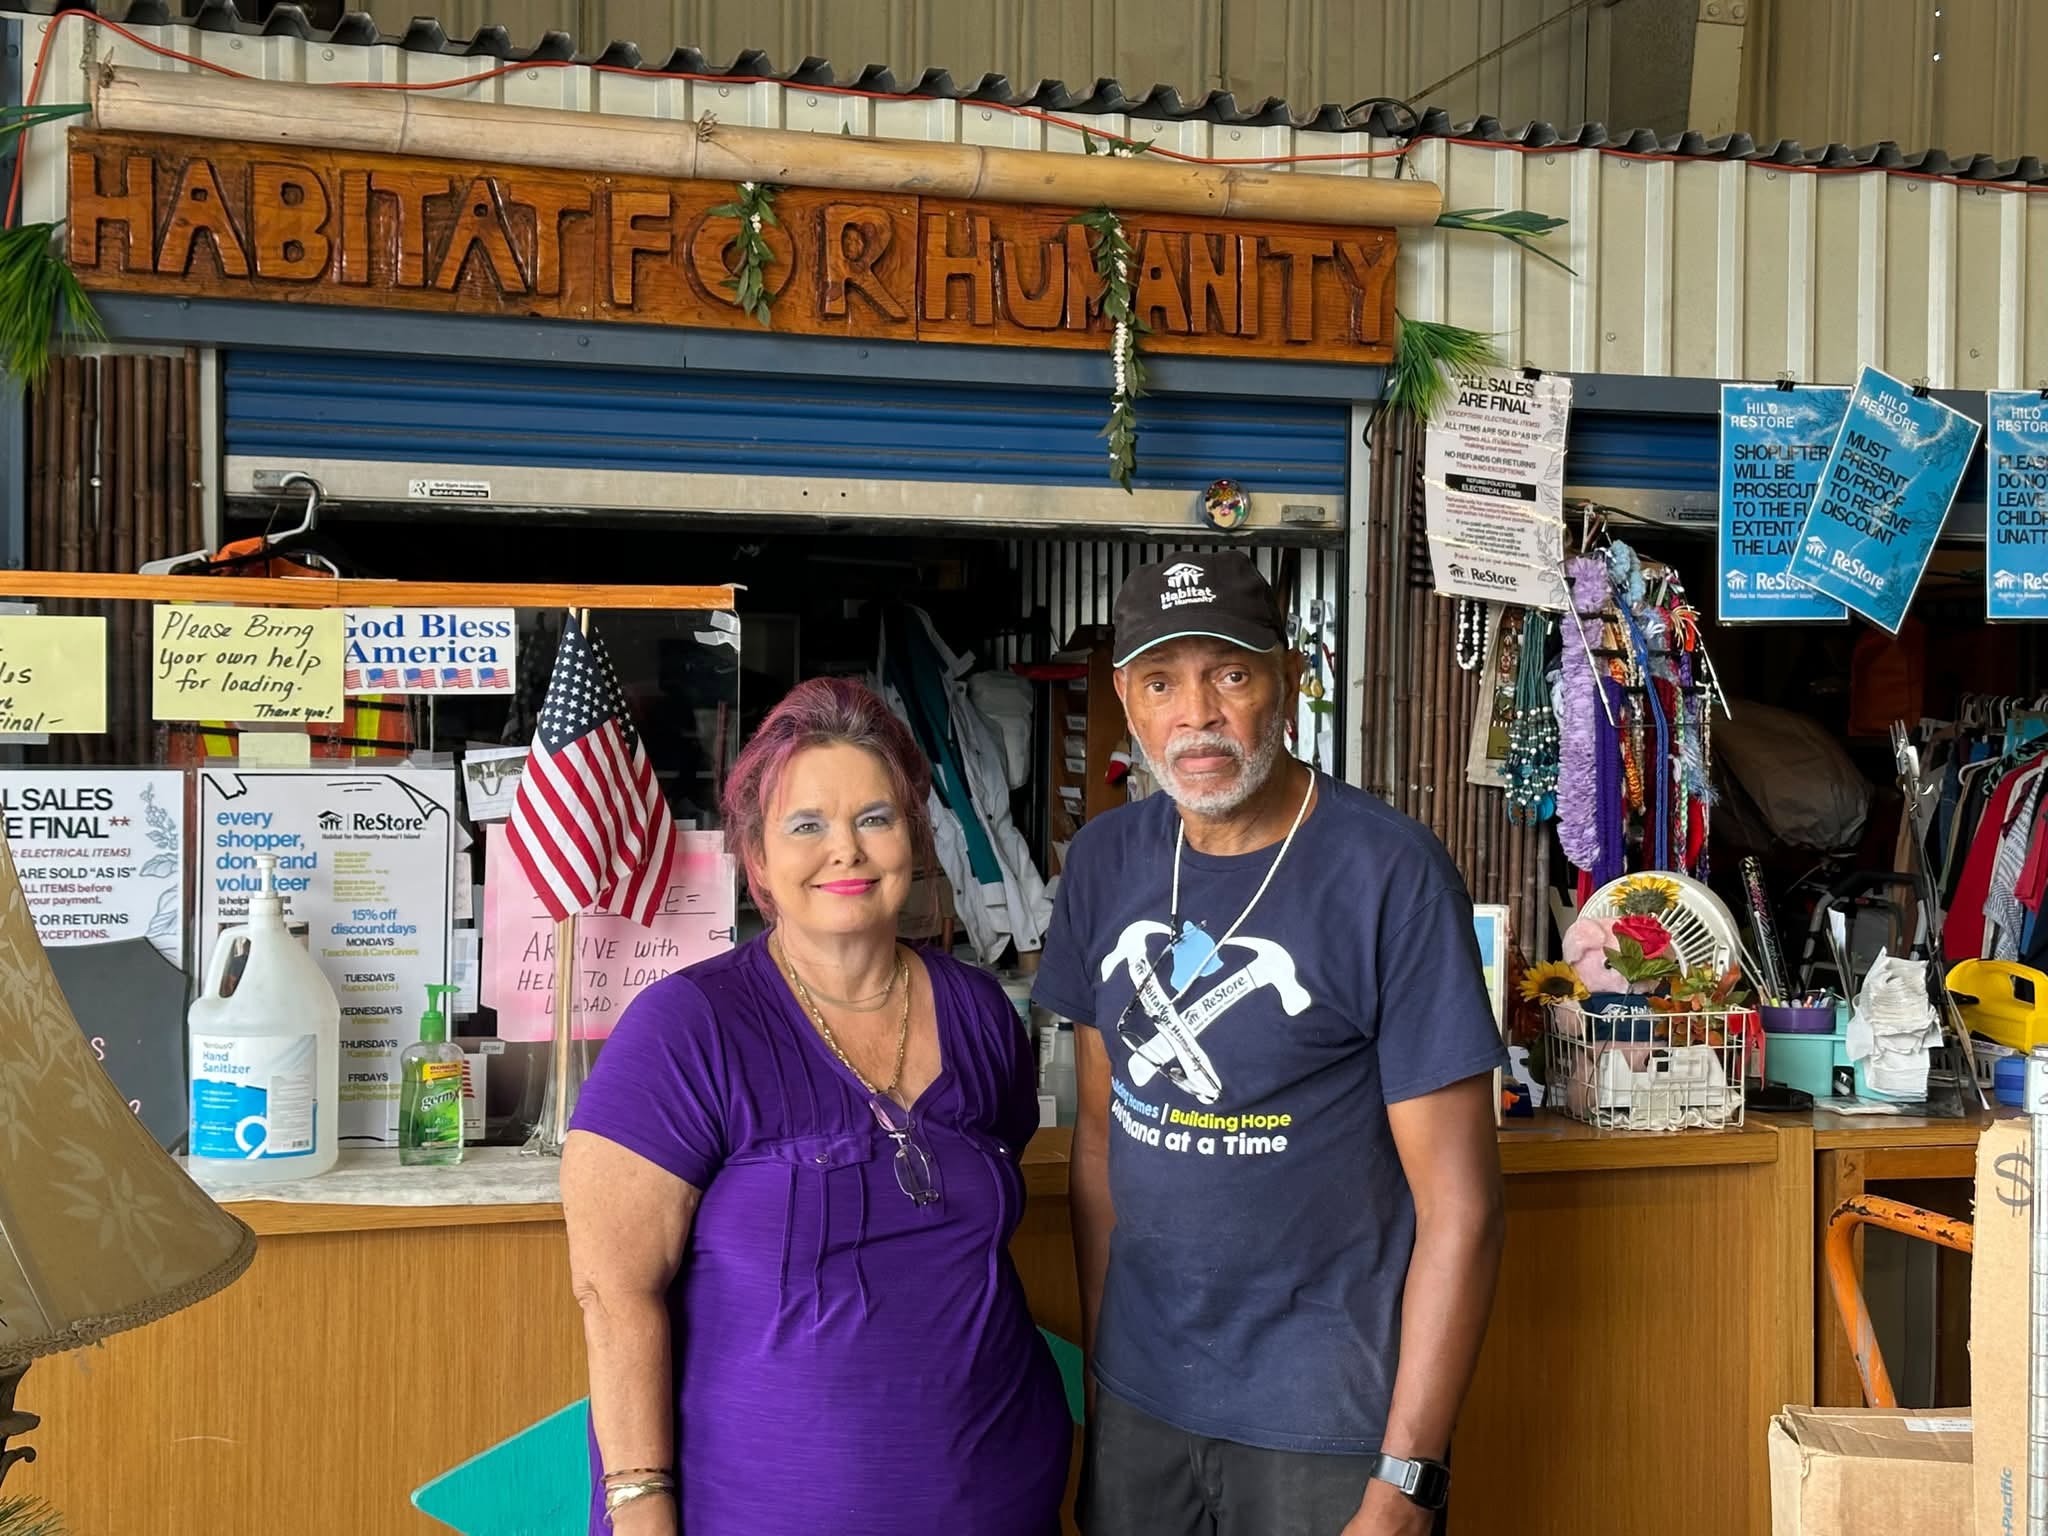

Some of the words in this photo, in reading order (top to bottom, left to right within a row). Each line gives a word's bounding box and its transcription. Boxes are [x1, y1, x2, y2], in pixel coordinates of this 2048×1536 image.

[68, 152, 593, 297] HABITAT
[610, 190, 908, 322] FOR
[1488, 378, 1534, 398] SALES
[1458, 391, 1488, 409] ARE
[1746, 402, 1778, 415] HILO
[1879, 390, 1909, 414] HILO
[1731, 415, 1794, 429] RESTORE
[1859, 395, 1919, 434] RESTORE
[2011, 407, 2041, 420] HILO
[1459, 423, 1480, 433] ITEMS
[1996, 420, 2048, 432] RESTOR
[1734, 444, 1832, 461] SHOPLIFTER
[1846, 430, 1892, 462] MUST
[1444, 450, 1455, 458] NO
[1457, 452, 1490, 463] REFUNDS
[1491, 457, 1503, 465] OR
[1503, 458, 1536, 469] RETURNS
[1840, 447, 1911, 489] PRESENT
[1998, 455, 2048, 471] PLEAS
[1734, 463, 1771, 480] WILL
[1774, 463, 1795, 479] BE
[1833, 464, 1907, 509] ID/PROOF
[1998, 473, 2020, 489] DO
[1461, 484, 1501, 496] ELECTRICAL
[1733, 482, 1817, 499] PROSECUT
[1998, 492, 2046, 508] LEAVE
[1733, 502, 1756, 517] TO
[1758, 502, 1791, 518] THE
[1830, 482, 1850, 503] TO
[1850, 493, 1911, 537] RECEIVE
[1732, 520, 1795, 536] EXTENT
[1821, 499, 1897, 546] DISCOUNT
[1732, 540, 1764, 555] THE
[1471, 568, 1517, 587] ReStore
[1831, 549, 1884, 591] ReStore
[1160, 587, 1212, 605] Habitat
[161, 611, 232, 641] Please
[244, 614, 314, 649] Bring
[418, 614, 511, 639] Bless
[344, 640, 498, 664] America
[216, 652, 257, 666] own
[267, 647, 321, 676] help
[176, 668, 211, 693] for
[221, 672, 302, 702] loading.
[254, 704, 301, 718] Thank
[305, 706, 334, 722] you!
[22, 788, 113, 812] SALES
[216, 811, 273, 830] every
[354, 813, 423, 831] ReStore
[216, 830, 305, 851] shopper,
[20, 849, 90, 858] ELECTRICAL
[92, 848, 131, 857] ITEMS)
[280, 852, 317, 870] and
[19, 868, 47, 879] ARE
[49, 868, 88, 879] SOLD
[40, 884, 76, 893] ITEMS
[77, 884, 113, 893] before
[216, 874, 311, 892] voluteer
[52, 896, 102, 907] payment.
[39, 914, 60, 926] OR
[62, 914, 129, 925] RETURNS
[352, 908, 377, 921] 15%
[379, 908, 397, 921] off
[38, 930, 110, 940] XCEPTIONS.
[330, 922, 385, 935] discount
[387, 922, 417, 936] days
[346, 938, 394, 948] MONDAYS
[522, 932, 620, 962] ARIVE
[634, 937, 679, 958] with
[344, 973, 395, 983] TUESDAYS
[583, 971, 608, 988] TO
[1202, 976, 1245, 1012] ReStore
[341, 1040, 398, 1049] THURSDAYS
[203, 1051, 229, 1062] Hand
[203, 1063, 251, 1074] Sanitizer
[348, 1073, 389, 1082] FRIDAYS
[1170, 1109, 1238, 1132] Building
[1242, 1113, 1292, 1130] Hope
[1165, 1131, 1191, 1152] at
[1197, 1138, 1215, 1155] a
[1223, 1132, 1288, 1156] Time
